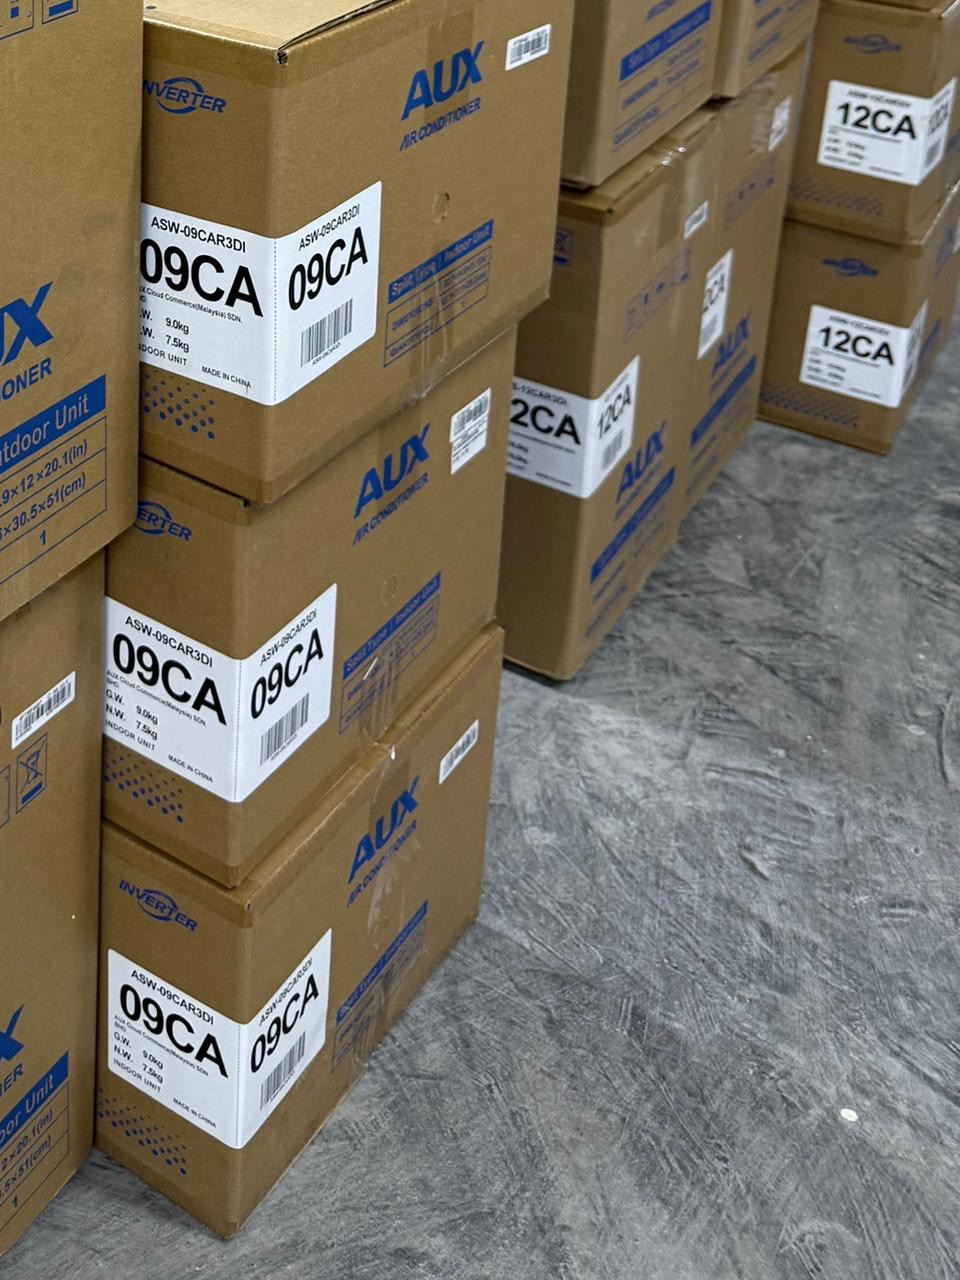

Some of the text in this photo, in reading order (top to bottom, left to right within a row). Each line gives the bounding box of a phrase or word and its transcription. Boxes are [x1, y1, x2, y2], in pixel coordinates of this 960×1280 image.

[143, 79, 226, 113] NVERTER
[400, 41, 485, 121] AUX
[400, 97, 481, 151] AIR CONDITIONER
[838, 101, 917, 140] 12CA
[151, 216, 246, 253] ASW-09CAR3DI
[298, 203, 360, 252] ASW-09CAR3DI
[140, 238, 263, 318] 09CA
[288, 226, 368, 311] 09CA
[165, 317, 190, 335] 9.0kg
[165, 334, 190, 353] 7.5kg
[711, 308, 751, 377] AUX
[820, 325, 894, 367] 12CA
[168, 353, 188, 366] UNIT
[201, 365, 251, 389] MADE CHINA
[55, 393, 90, 431] Unit
[510, 398, 581, 446] 2CA
[598, 384, 632, 440] 12CA
[353, 422, 431, 519] AUX
[615, 420, 666, 503] AUX
[39, 528, 48, 546] 1
[138, 504, 192, 542] ERTER
[125, 616, 213, 668] ASW-09CAR3DI
[260, 608, 317, 666] ASW-09CAR3DI
[113, 633, 227, 726] 09CA
[251, 627, 324, 720] 09CA
[106, 689, 158, 725] G.W. 9.0kg
[106, 703, 158, 741] N.W. 7.5kg
[137, 736, 156, 751] UNIT
[347, 775, 419, 884] AUX
[118, 879, 198, 932] INVERTER
[131, 969, 214, 1025] ASW-09CAR3DI
[114, 1032, 132, 1049] G.W.
[120, 983, 228, 1079] 09CA
[251, 973, 319, 1073] 09CA
[114, 1045, 133, 1063] N.W.
[25, 1074, 54, 1113] Unit
